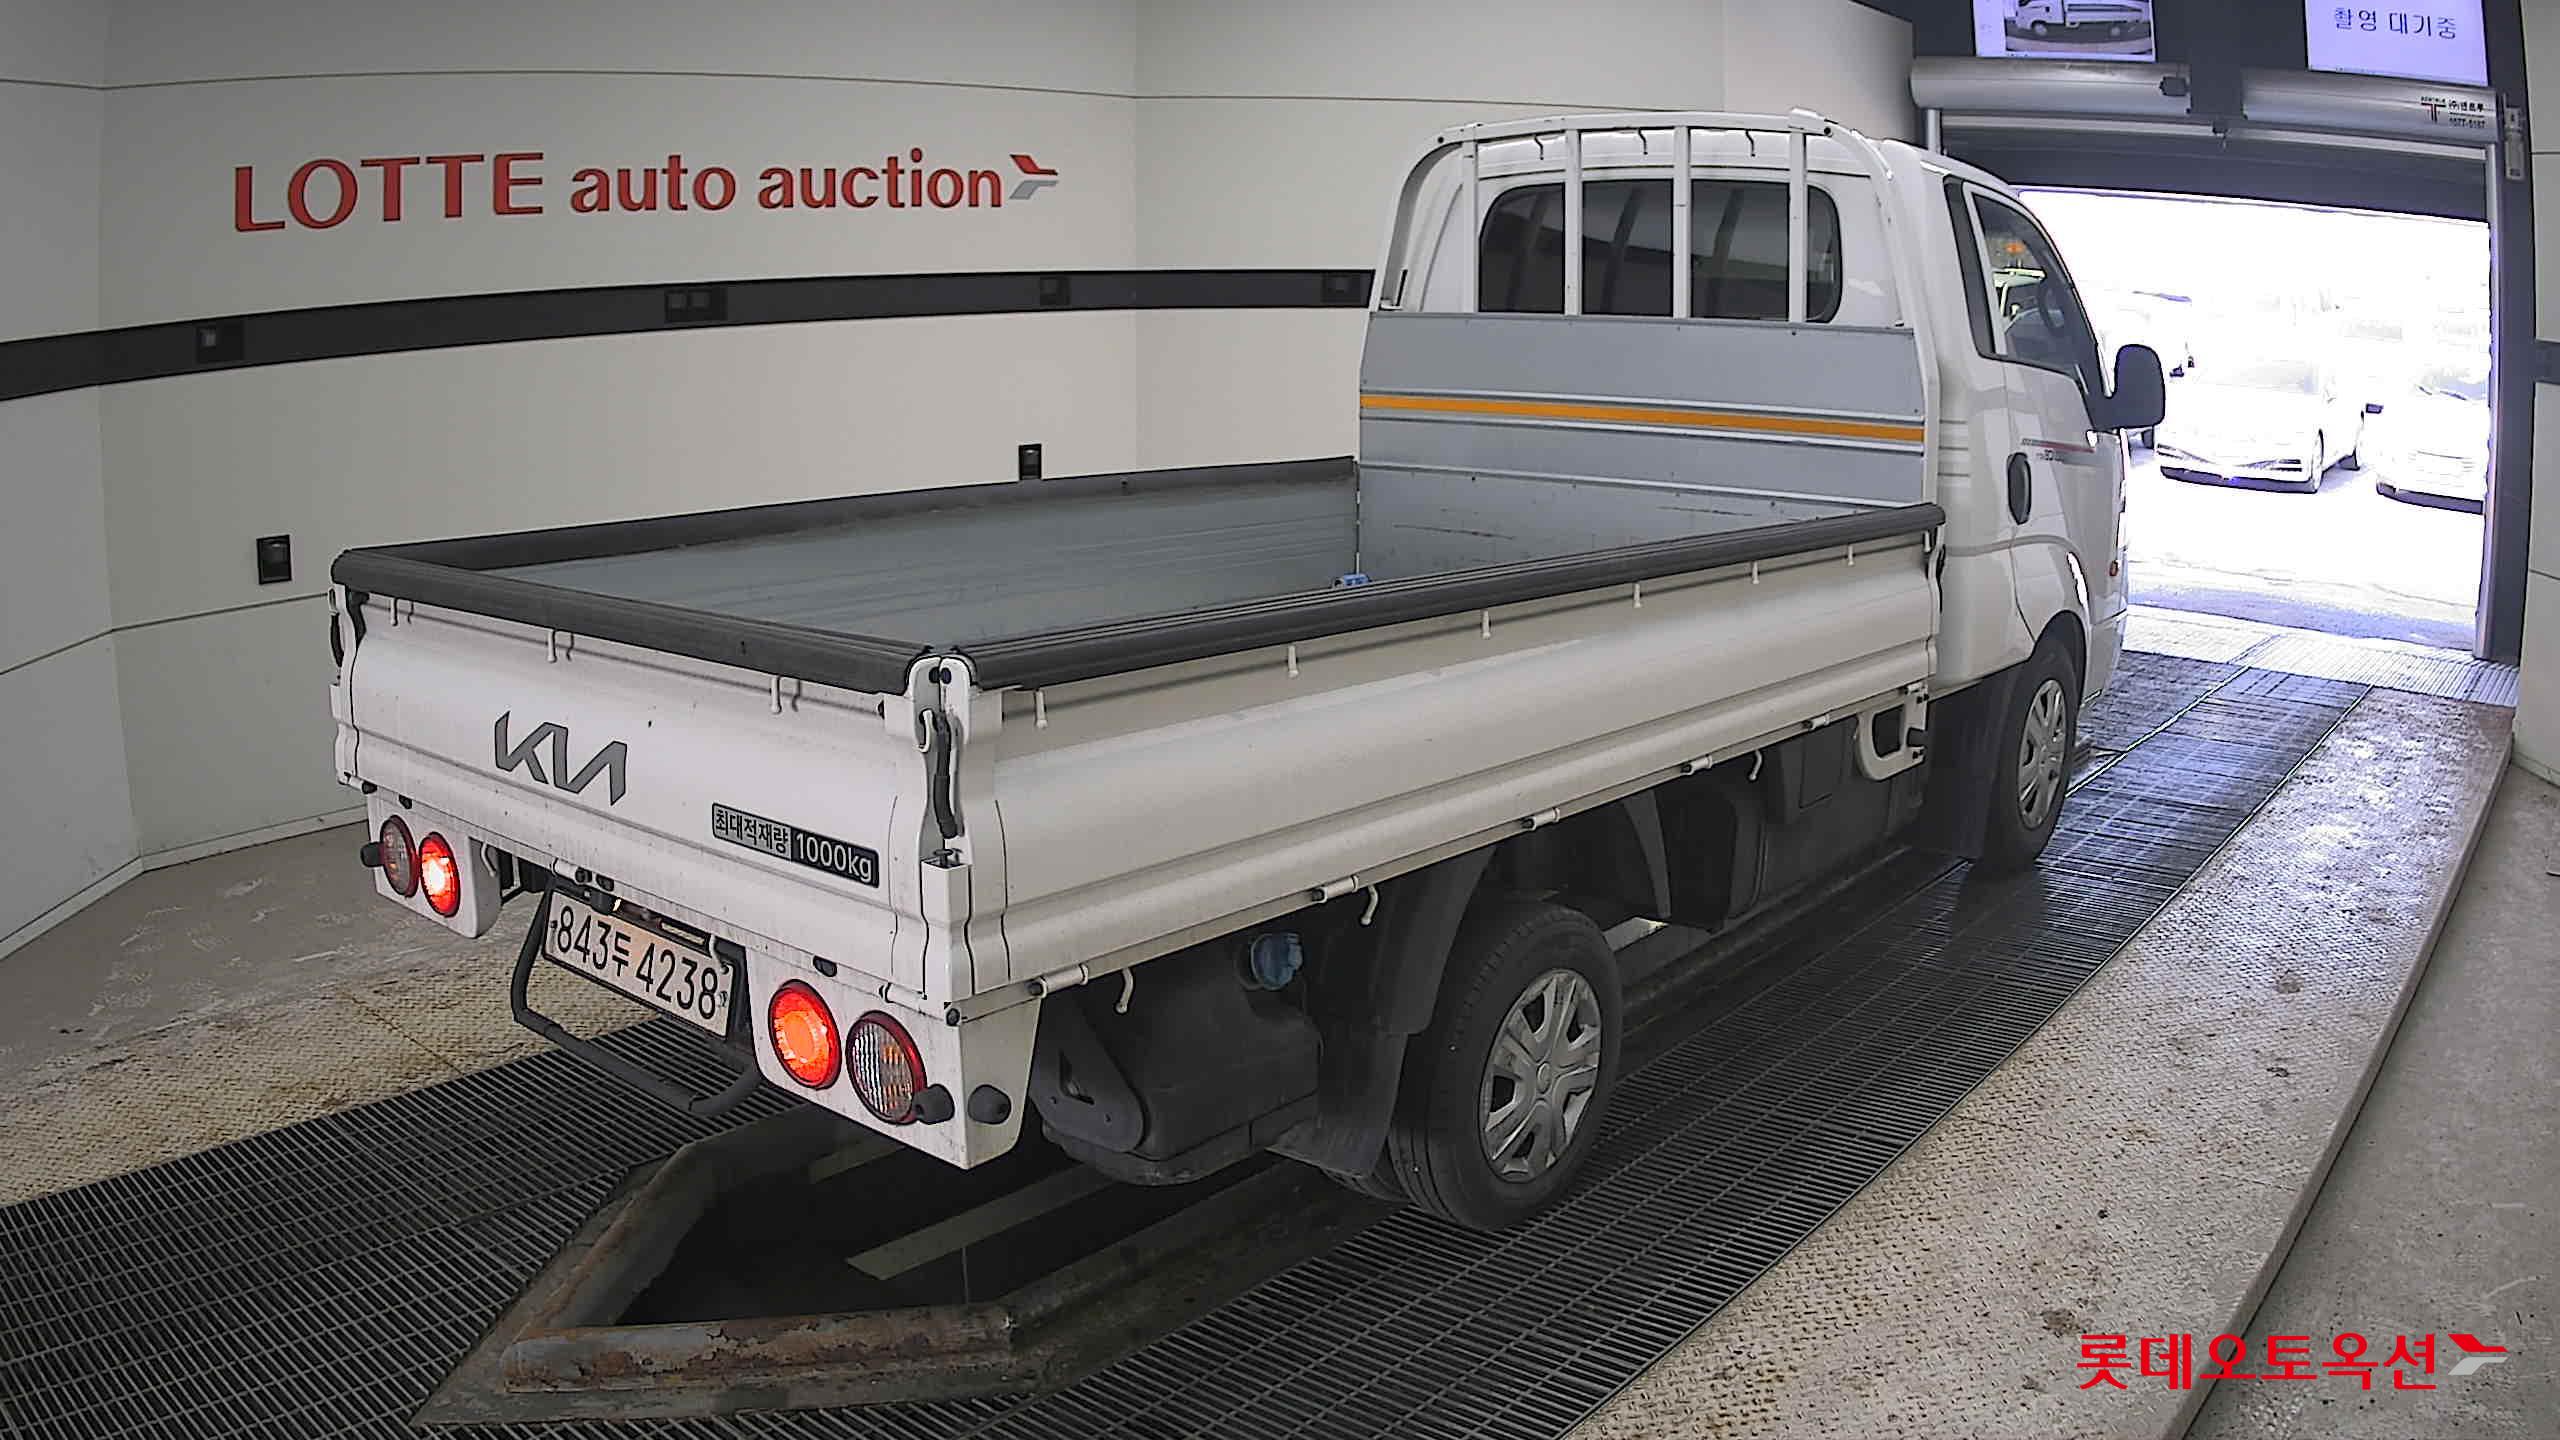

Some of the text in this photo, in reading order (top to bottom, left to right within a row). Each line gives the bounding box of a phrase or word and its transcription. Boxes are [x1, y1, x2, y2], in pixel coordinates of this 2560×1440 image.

[2335, 8, 2377, 32] 촬영
[235, 147, 1003, 232] LOTTE auto auction
[494, 710, 628, 806] KIA
[715, 808, 873, 883] 최대적재량 1000kg
[556, 905, 718, 1020] 843두 4238
